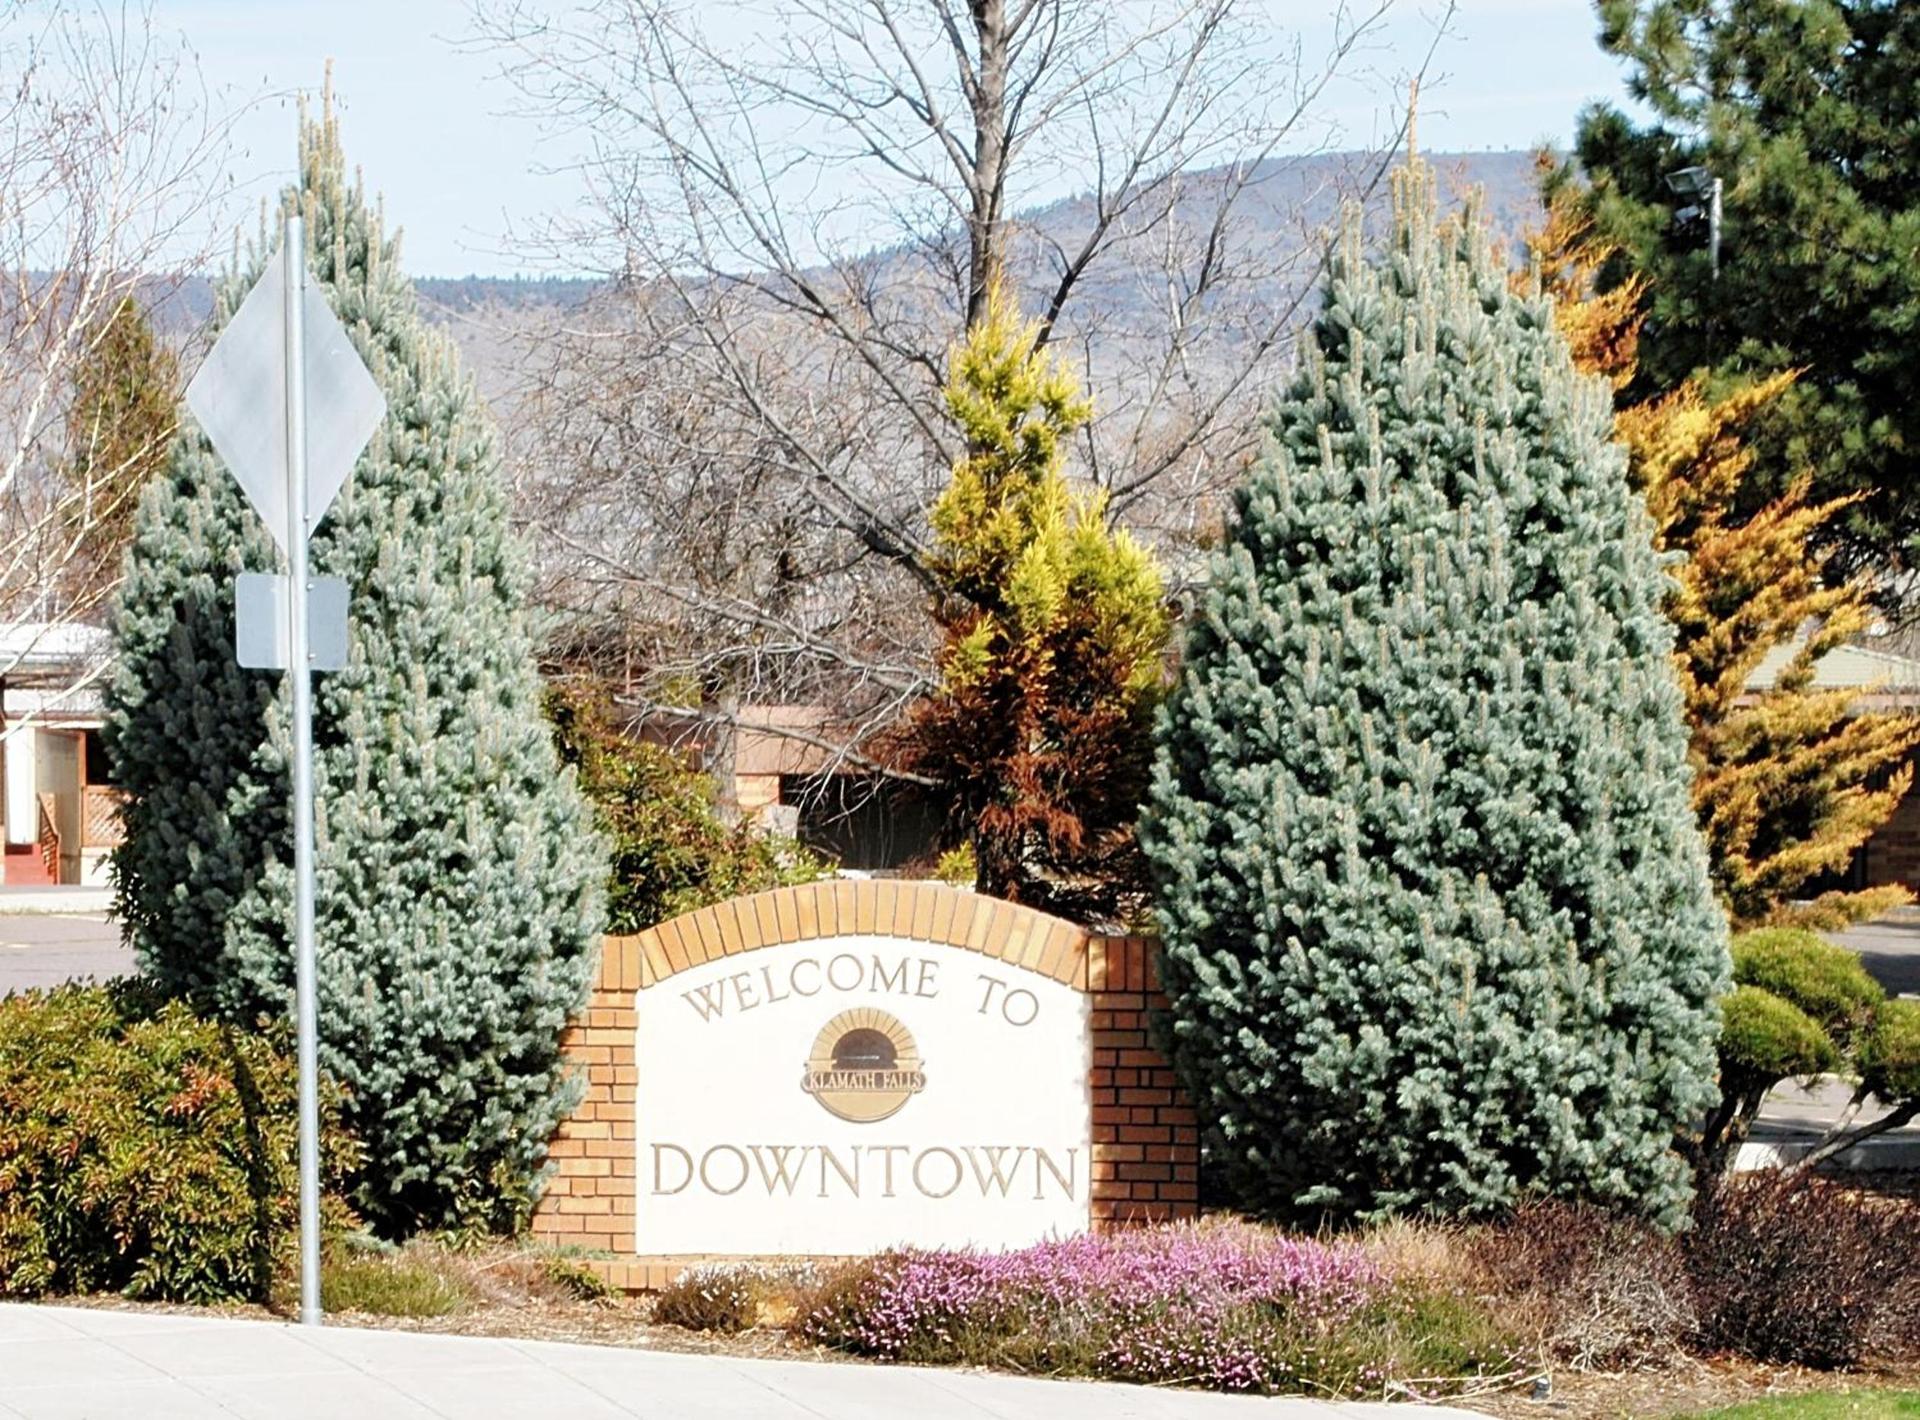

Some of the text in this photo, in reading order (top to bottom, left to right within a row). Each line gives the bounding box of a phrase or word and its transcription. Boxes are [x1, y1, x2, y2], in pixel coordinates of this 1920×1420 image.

[680, 953, 1040, 1027] WELCOME TO
[809, 1071, 922, 1090] KLAMATH FALLS
[650, 1143, 1079, 1202] DOWNTOWN
